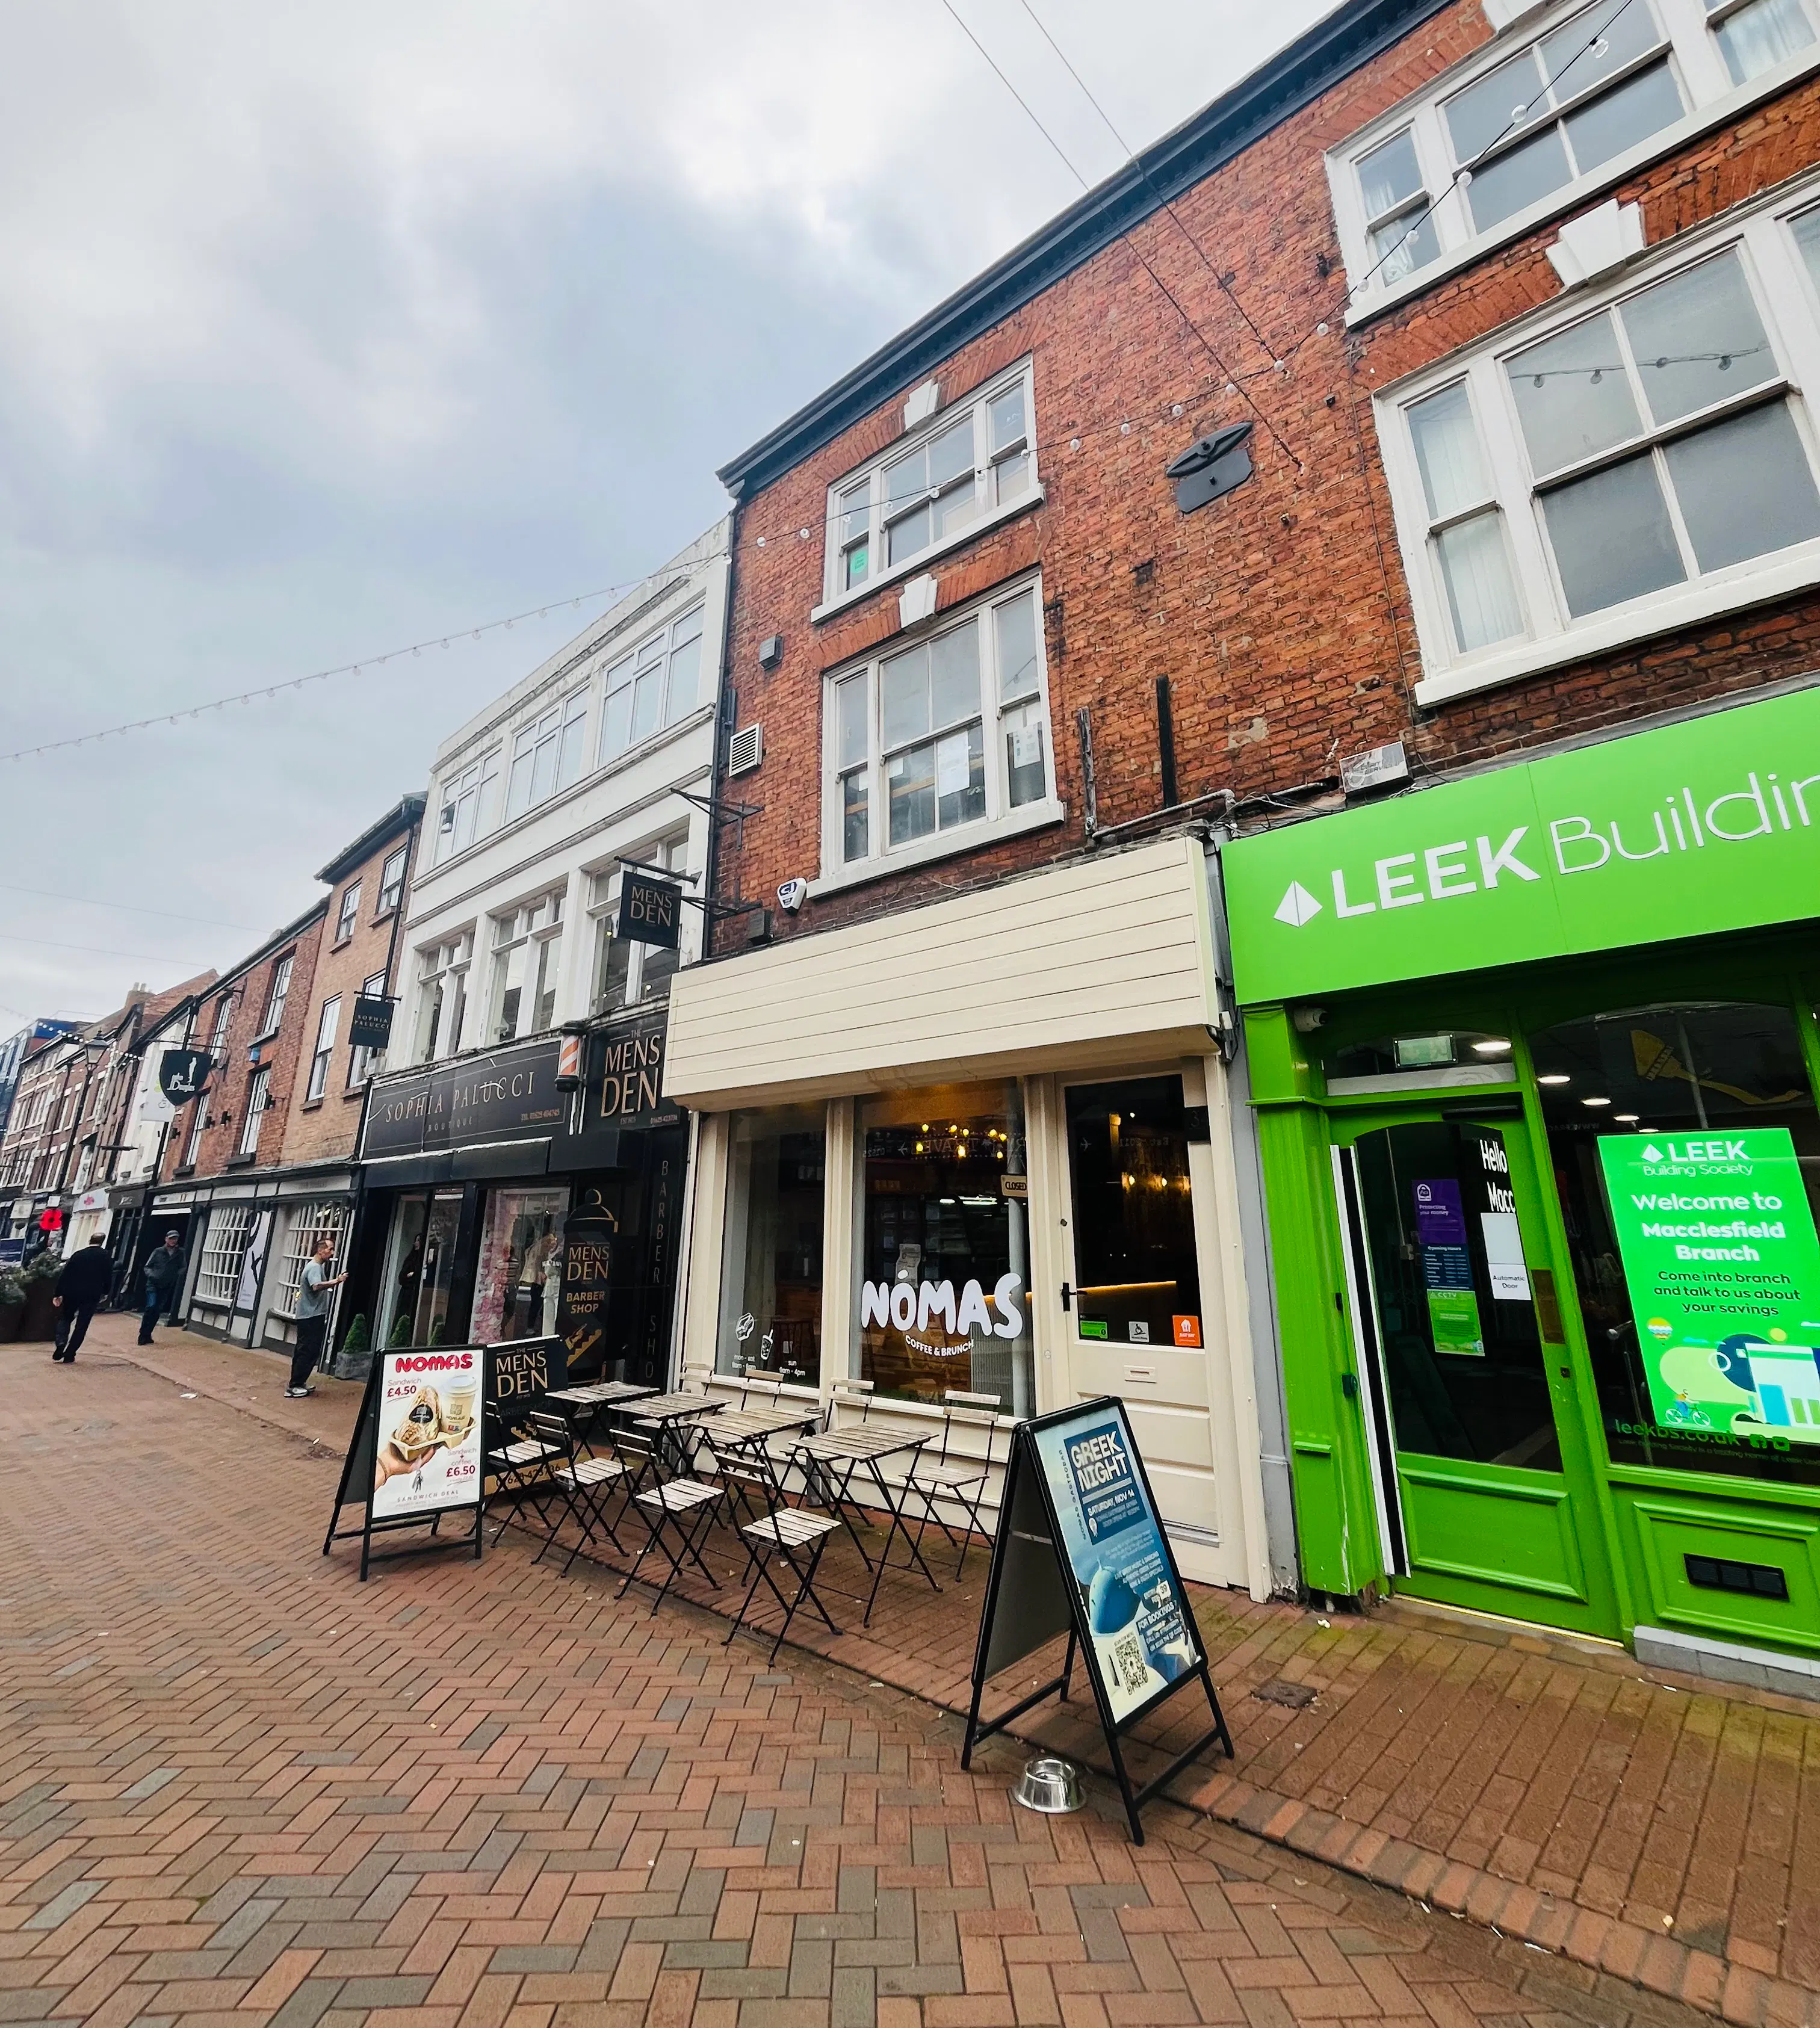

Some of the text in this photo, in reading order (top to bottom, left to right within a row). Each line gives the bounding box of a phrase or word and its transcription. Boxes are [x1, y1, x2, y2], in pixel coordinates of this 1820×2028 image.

[1331, 826, 1540, 918] LEEK
[631, 885, 673, 908] MENS
[630, 900, 672, 927] DEN
[354, 1020, 389, 1029] PALUCCI
[358, 1015, 388, 1023] SOPHIA
[631, 1028, 642, 1038] THE
[605, 1034, 661, 1075] MENS
[385, 1071, 534, 1123] SOPHIA PALUCCI
[601, 1067, 658, 1118] DEN
[428, 1116, 473, 1132] BOUTIQUE
[1480, 1139, 1508, 1173] Hello
[1667, 1140, 1752, 1162] LEEK
[1642, 1163, 1753, 1178] Building Society
[1005, 1181, 1027, 1191] CLOSED
[1487, 1181, 1516, 1213] Macc
[1630, 1191, 1783, 1211] Welcome to
[1641, 1220, 1786, 1238] Macclesfield
[568, 1246, 610, 1261] MENS
[1675, 1244, 1760, 1261] Branch
[567, 1261, 608, 1281] DEN
[645, 1160, 669, 1386] BARBER SHO
[1658, 1271, 1791, 1284] Come into branch
[566, 1291, 605, 1302] BARBER
[1654, 1286, 1801, 1300] and talk to us about
[570, 1303, 599, 1314] SHOP
[1682, 1303, 1779, 1317] your savings
[905, 1334, 974, 1356] COFFEE & BRUNCH
[395, 1353, 473, 1373] NOMAS
[496, 1350, 546, 1374] MENS
[794, 1368, 806, 1377] 4pm
[388, 1377, 422, 1387] Sandwich
[497, 1367, 548, 1398] DEN
[386, 1385, 417, 1398] £4.50
[1615, 1418, 1741, 1446] leekbs.co.uk
[447, 1447, 477, 1456] Sandwich
[1071, 1430, 1123, 1468] GREEK
[446, 1465, 476, 1478] £6.50
[1077, 1452, 1128, 1492] NIGHT
[397, 1493, 438, 1503] SANDWICH
[1115, 1491, 1127, 1504] NOV
[1160, 1584, 1168, 1594] 39
[1138, 1619, 1149, 1631] FOR
[1147, 1601, 1175, 1624] BOOKINGS
